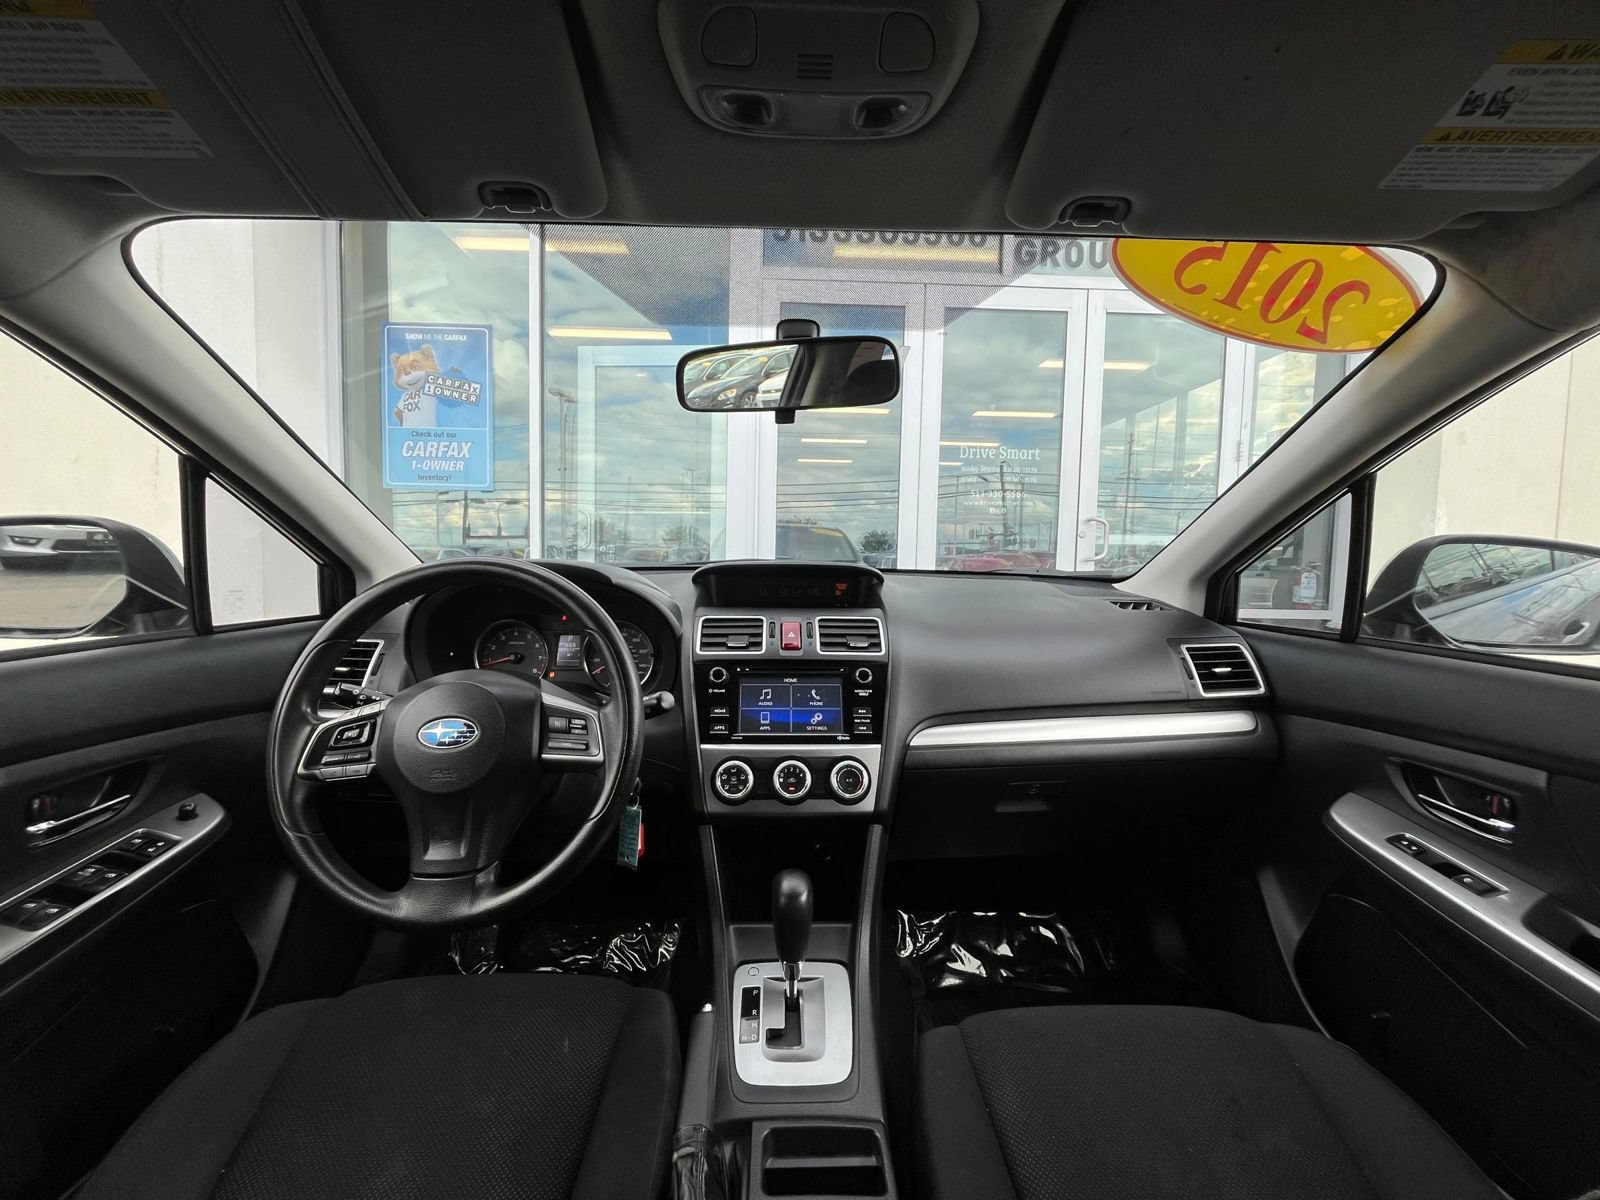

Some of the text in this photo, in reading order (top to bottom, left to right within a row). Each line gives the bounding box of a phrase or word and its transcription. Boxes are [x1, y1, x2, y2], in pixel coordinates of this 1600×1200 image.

[405, 333, 423, 341] SHOW
[444, 334, 468, 342] CARFAX
[428, 375, 479, 394] CARFAX
[403, 390, 421, 402] CAR
[403, 401, 421, 413] FOX
[402, 440, 473, 458] CARFAX
[960, 446, 1040, 460] Drive Smart
[411, 459, 465, 472] 1-OWNER
[418, 473, 451, 482] Inventory!
